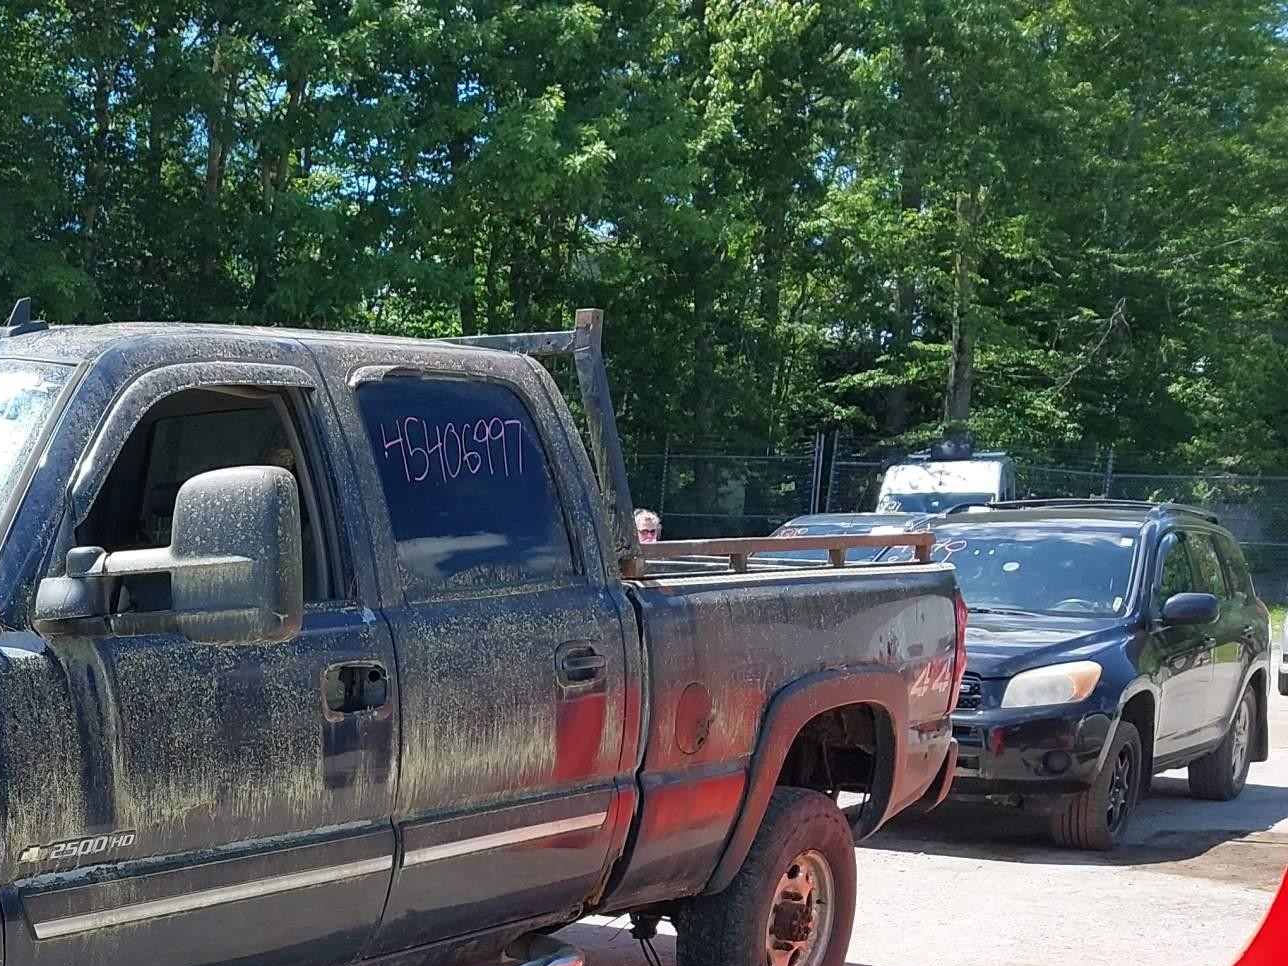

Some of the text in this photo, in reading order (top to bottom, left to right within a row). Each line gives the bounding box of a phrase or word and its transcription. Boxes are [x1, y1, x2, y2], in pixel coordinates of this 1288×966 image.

[380, 416, 523, 483] 45406997
[50, 834, 135, 859] 2500 HD
